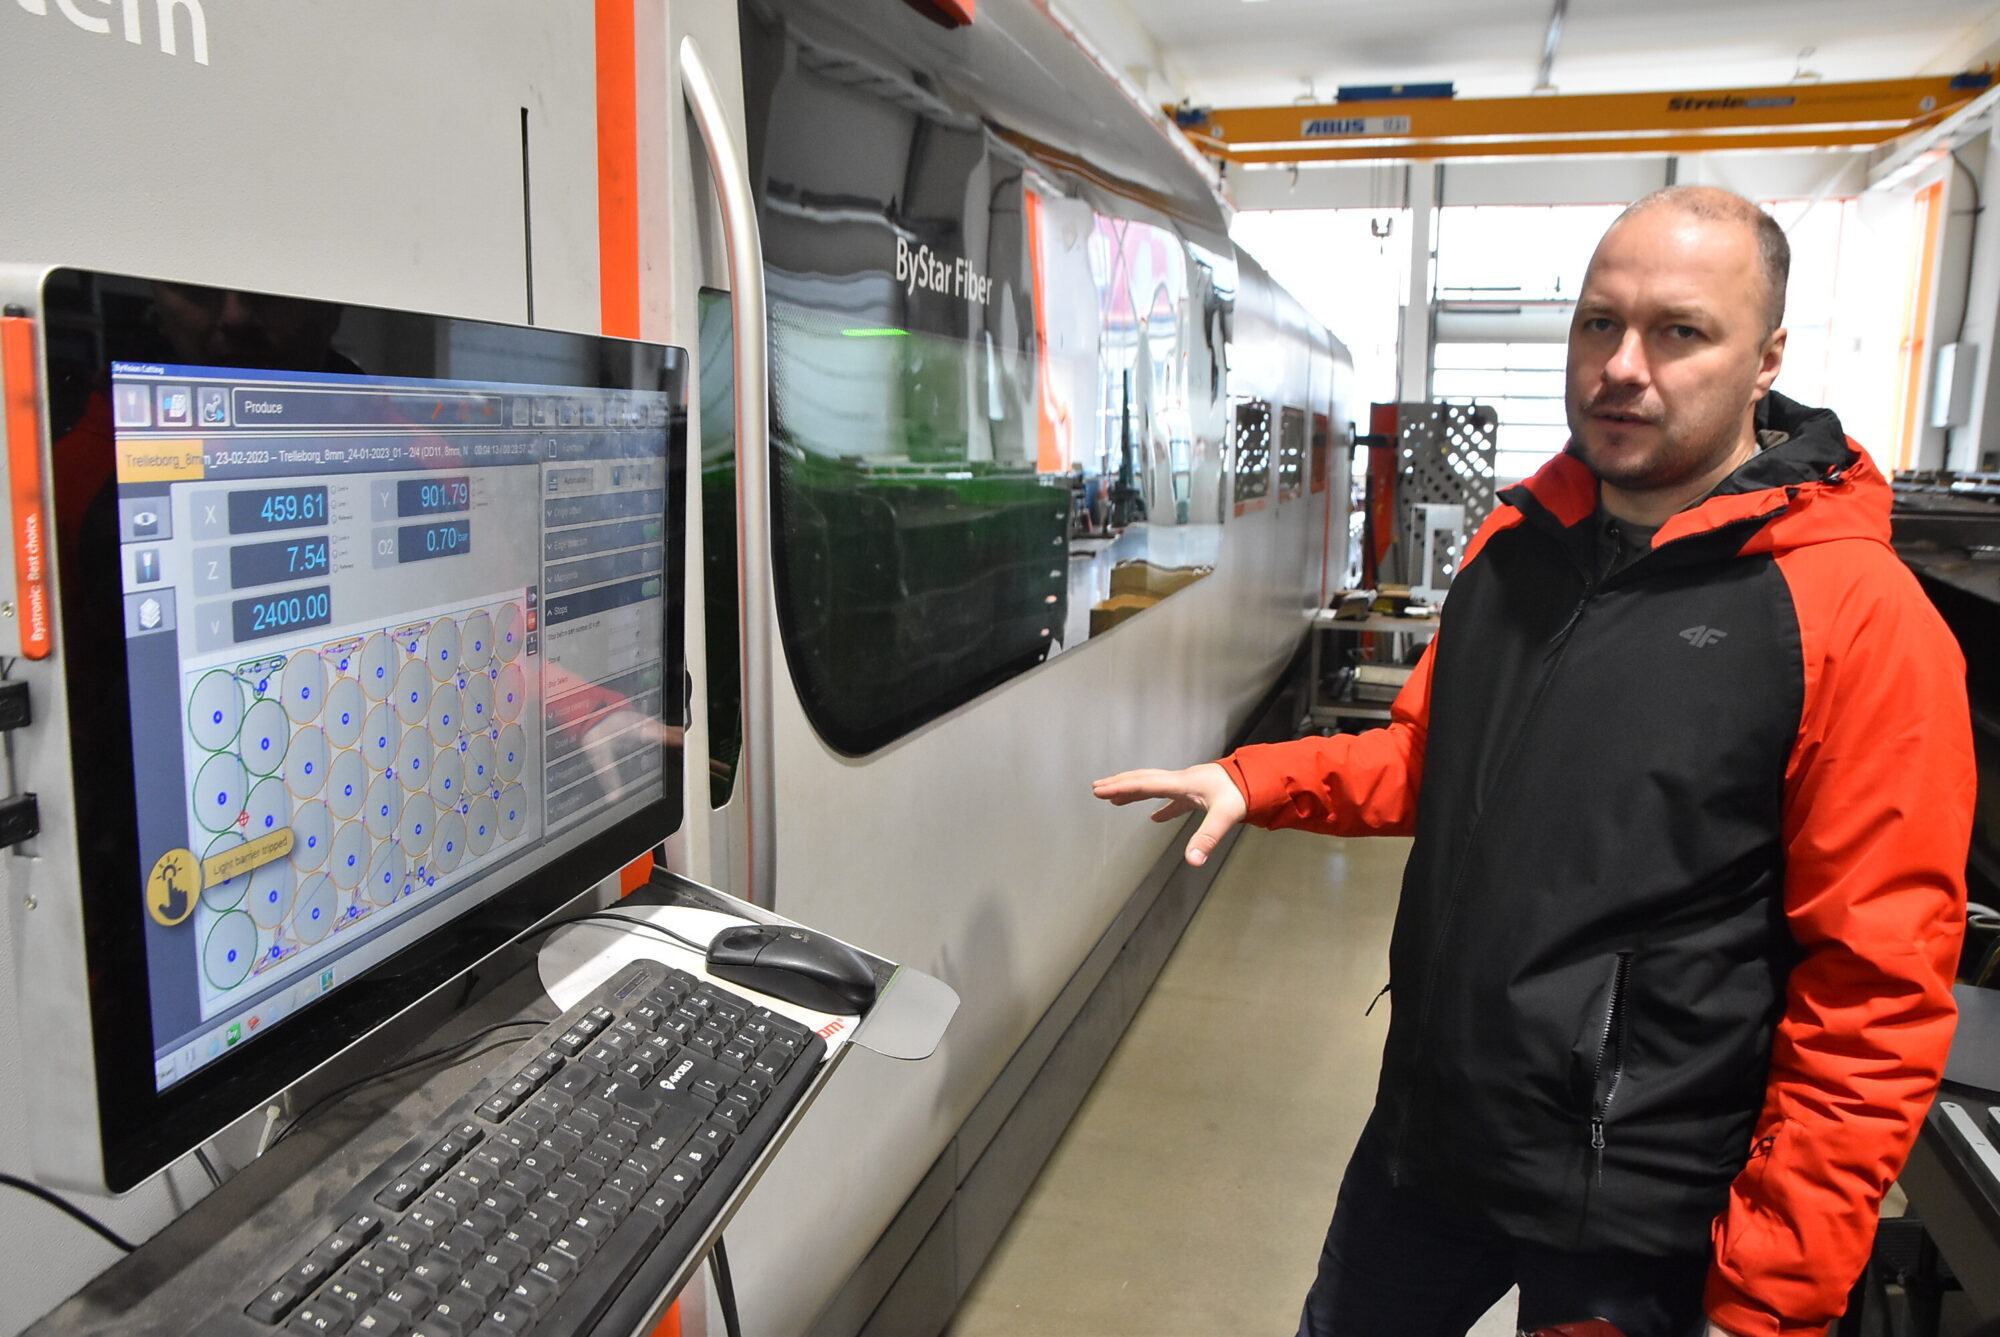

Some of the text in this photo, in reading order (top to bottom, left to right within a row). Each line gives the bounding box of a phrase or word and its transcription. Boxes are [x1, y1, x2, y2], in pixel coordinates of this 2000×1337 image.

[896, 236, 992, 306] ByStar Fiber
[245, 401, 283, 414] Produce
[126, 450, 269, 469] Trelleborg_8mm_23-02-2023
[381, 483, 468, 509] Y 901.79
[205, 493, 324, 525] X 459.61
[426, 527, 457, 551] 0.70
[207, 543, 327, 580] Z 7.54
[252, 593, 329, 632] 2400.00
[553, 606, 568, 616] Stops
[213, 836, 288, 876] Light barrier tripped
[669, 1060, 694, 1084] 4WORLD
[485, 1198, 496, 1206] U
[463, 1219, 473, 1227] Y
[576, 1217, 588, 1227] M
[508, 1232, 519, 1240] H
[439, 1242, 450, 1250] T
[555, 1239, 569, 1251] N
[486, 1255, 497, 1263] G
[302, 1264, 314, 1274] F2
[416, 1266, 428, 1275] R
[538, 1263, 548, 1271] B
[461, 1279, 471, 1288] F
[516, 1285, 527, 1294] V
[347, 1292, 357, 1300] 3
[388, 1291, 402, 1301] E
[438, 1305, 449, 1314] D
[494, 1312, 505, 1321] C
[316, 1319, 327, 1328] 2
